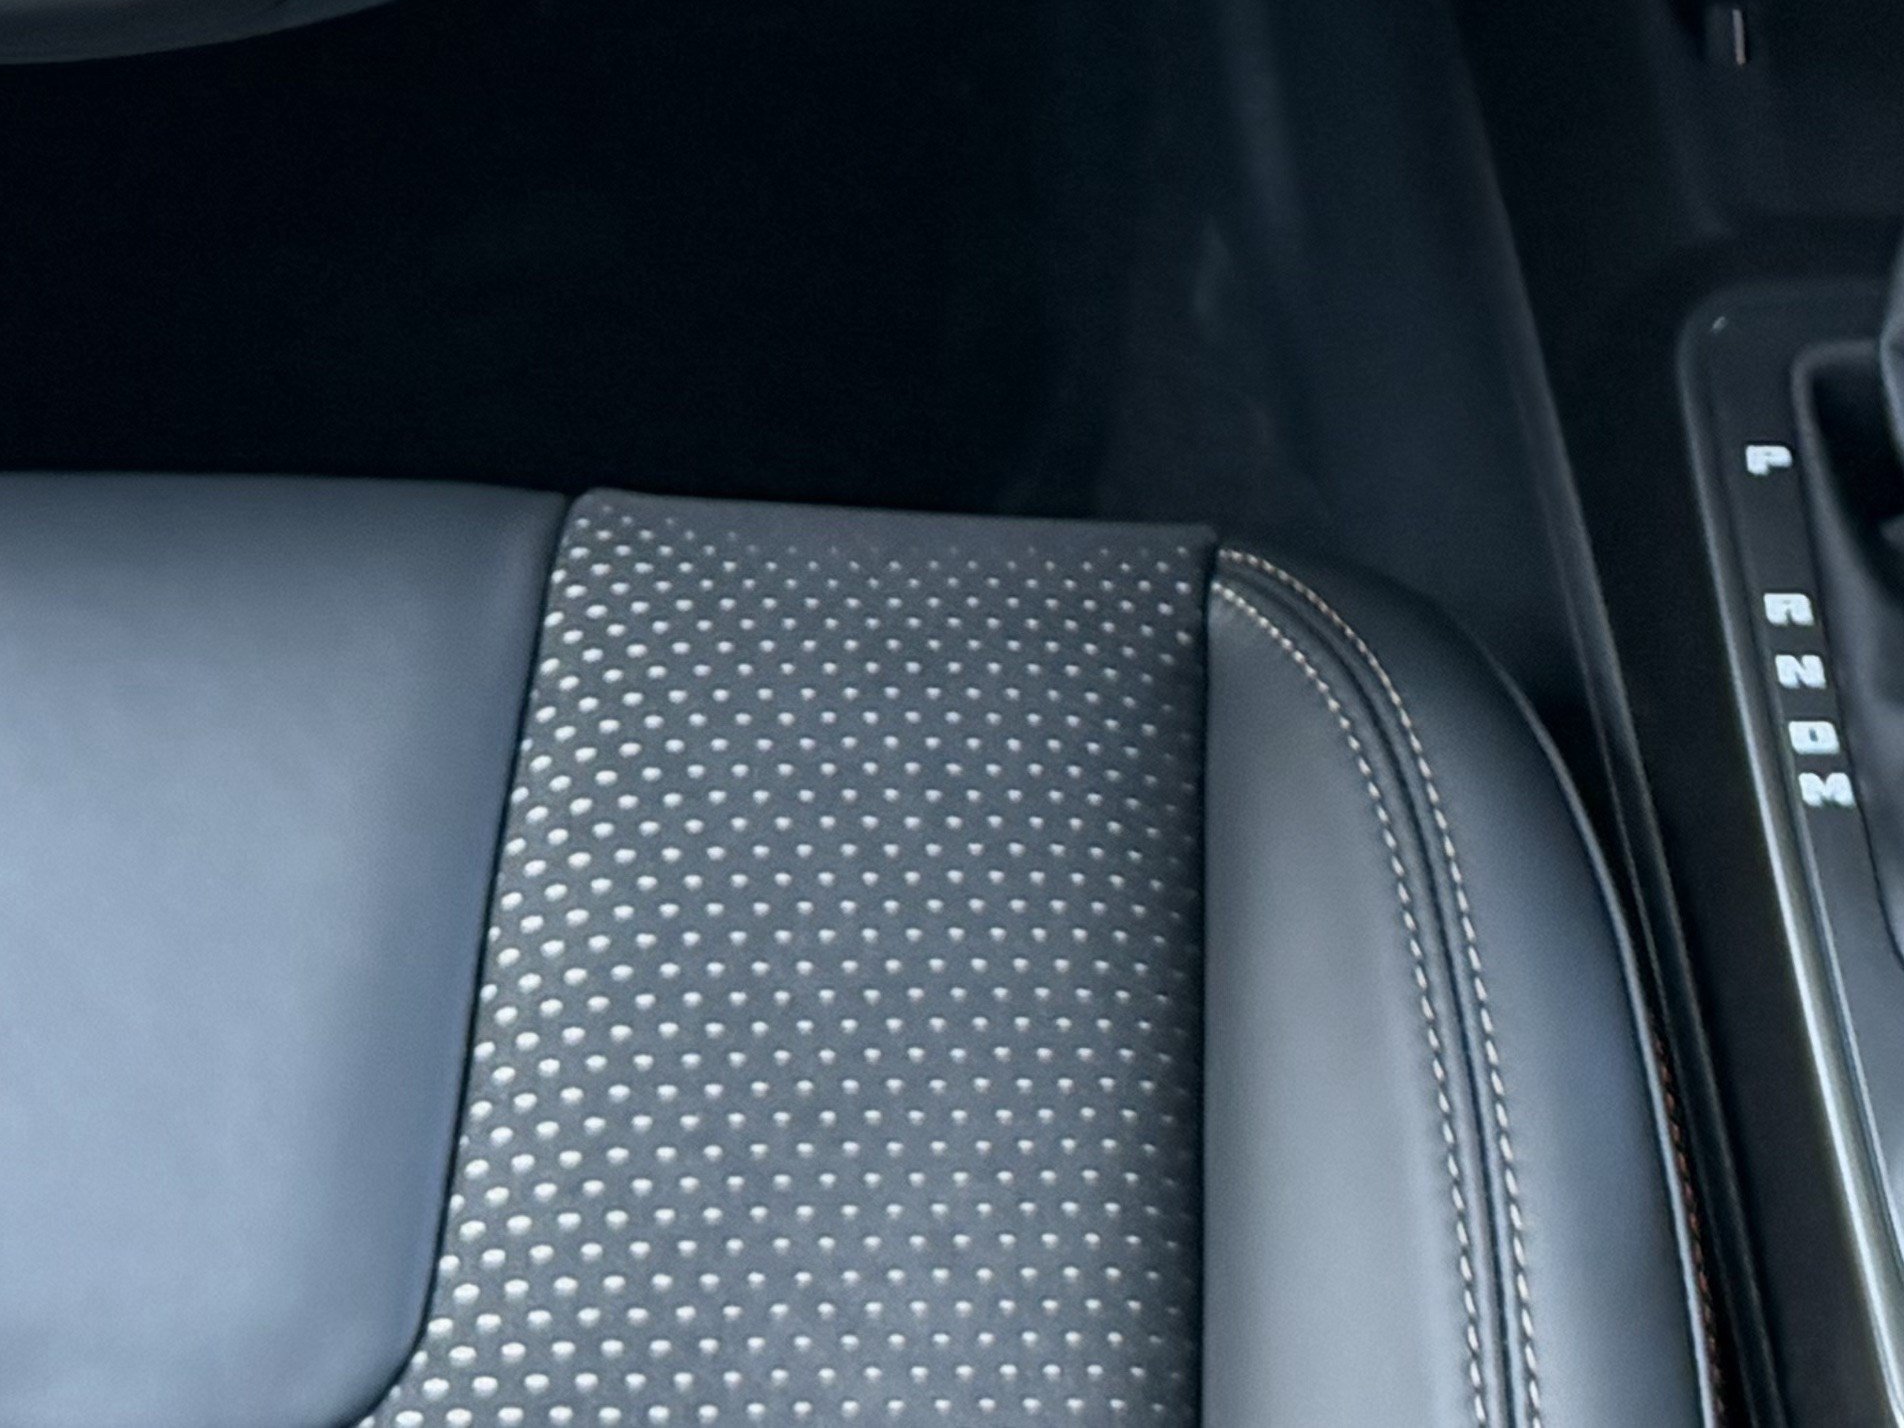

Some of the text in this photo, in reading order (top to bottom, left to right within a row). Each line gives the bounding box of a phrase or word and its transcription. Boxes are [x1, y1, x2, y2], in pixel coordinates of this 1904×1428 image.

[1745, 445, 1793, 476] P
[1775, 654, 1827, 689] N
[1798, 772, 1857, 808] M
